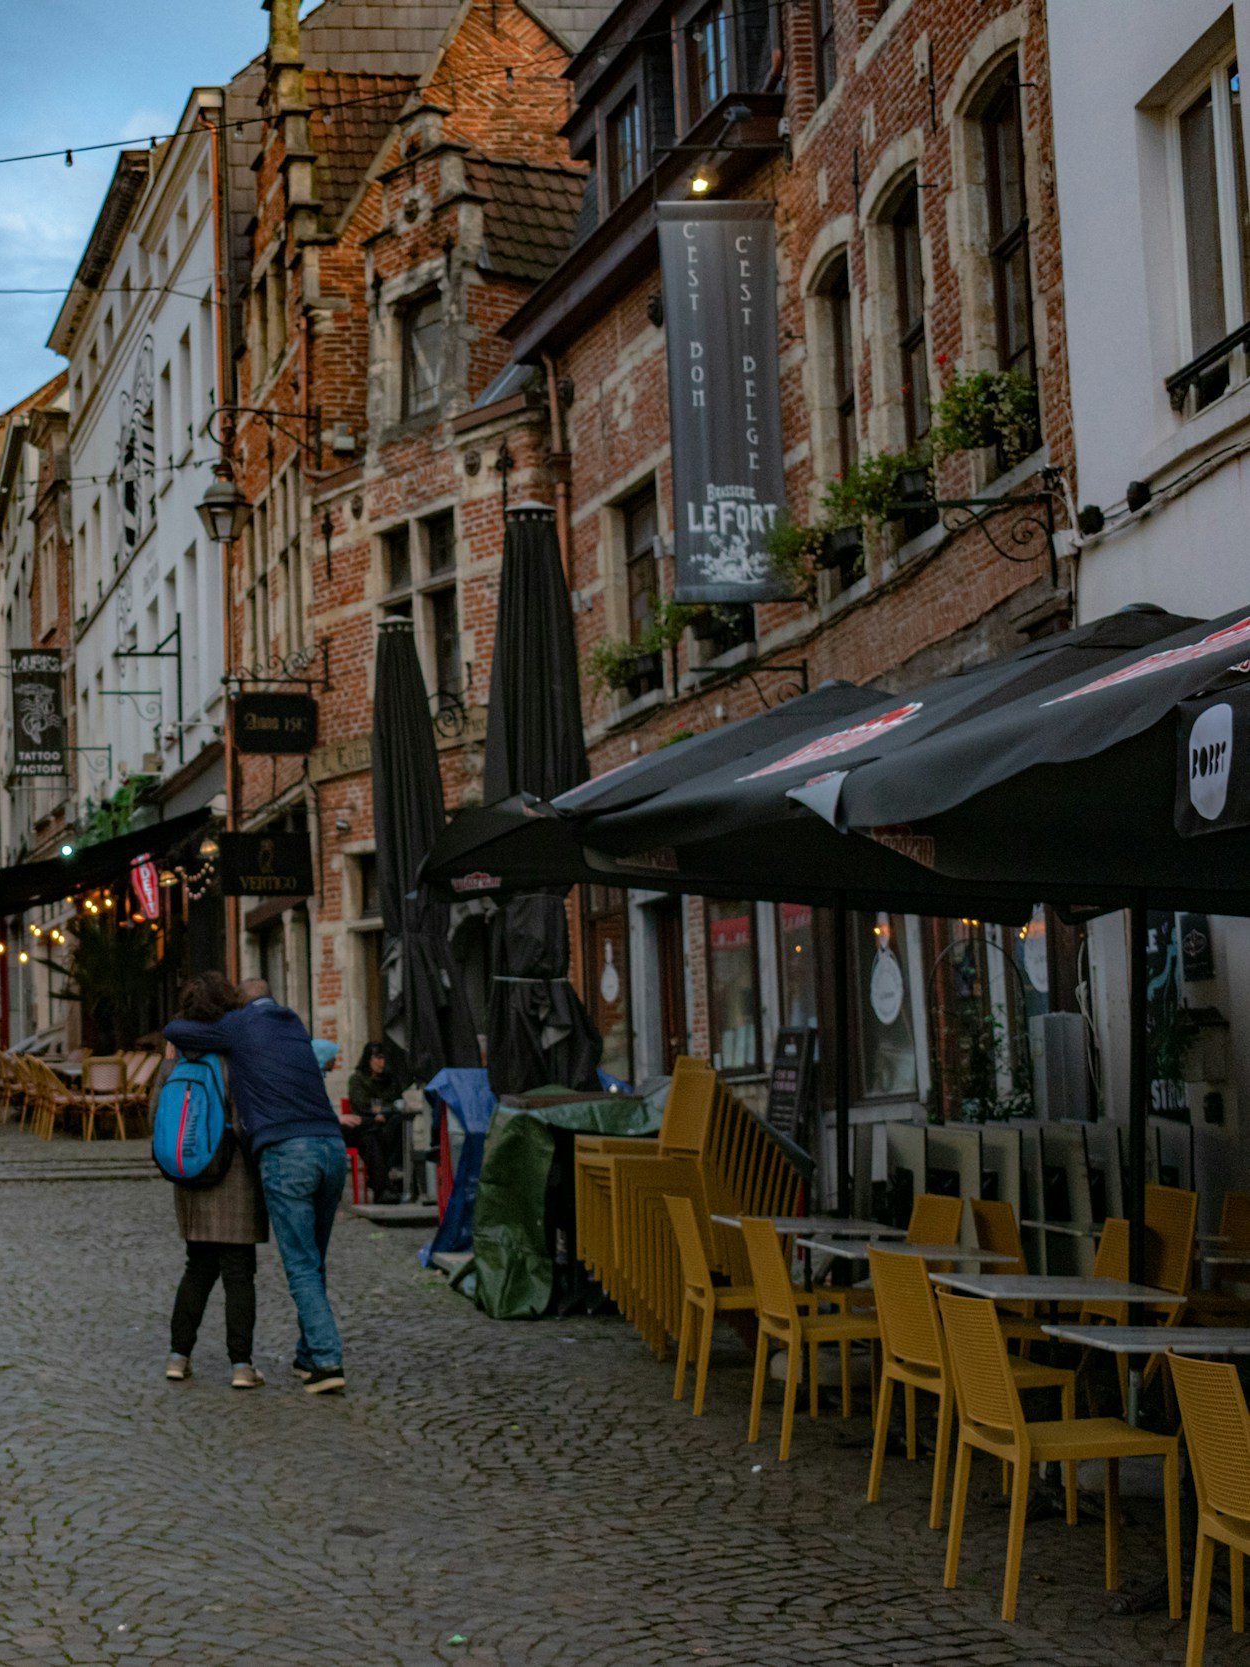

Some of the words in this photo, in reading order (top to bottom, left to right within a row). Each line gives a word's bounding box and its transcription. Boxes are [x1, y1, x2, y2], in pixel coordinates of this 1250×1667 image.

[682, 221, 700, 312] C'EST
[735, 236, 752, 325] C'EST
[18, 751, 61, 761] TATTOO
[15, 764, 64, 774] FACTORY
[238, 875, 298, 891] VERTIGO
